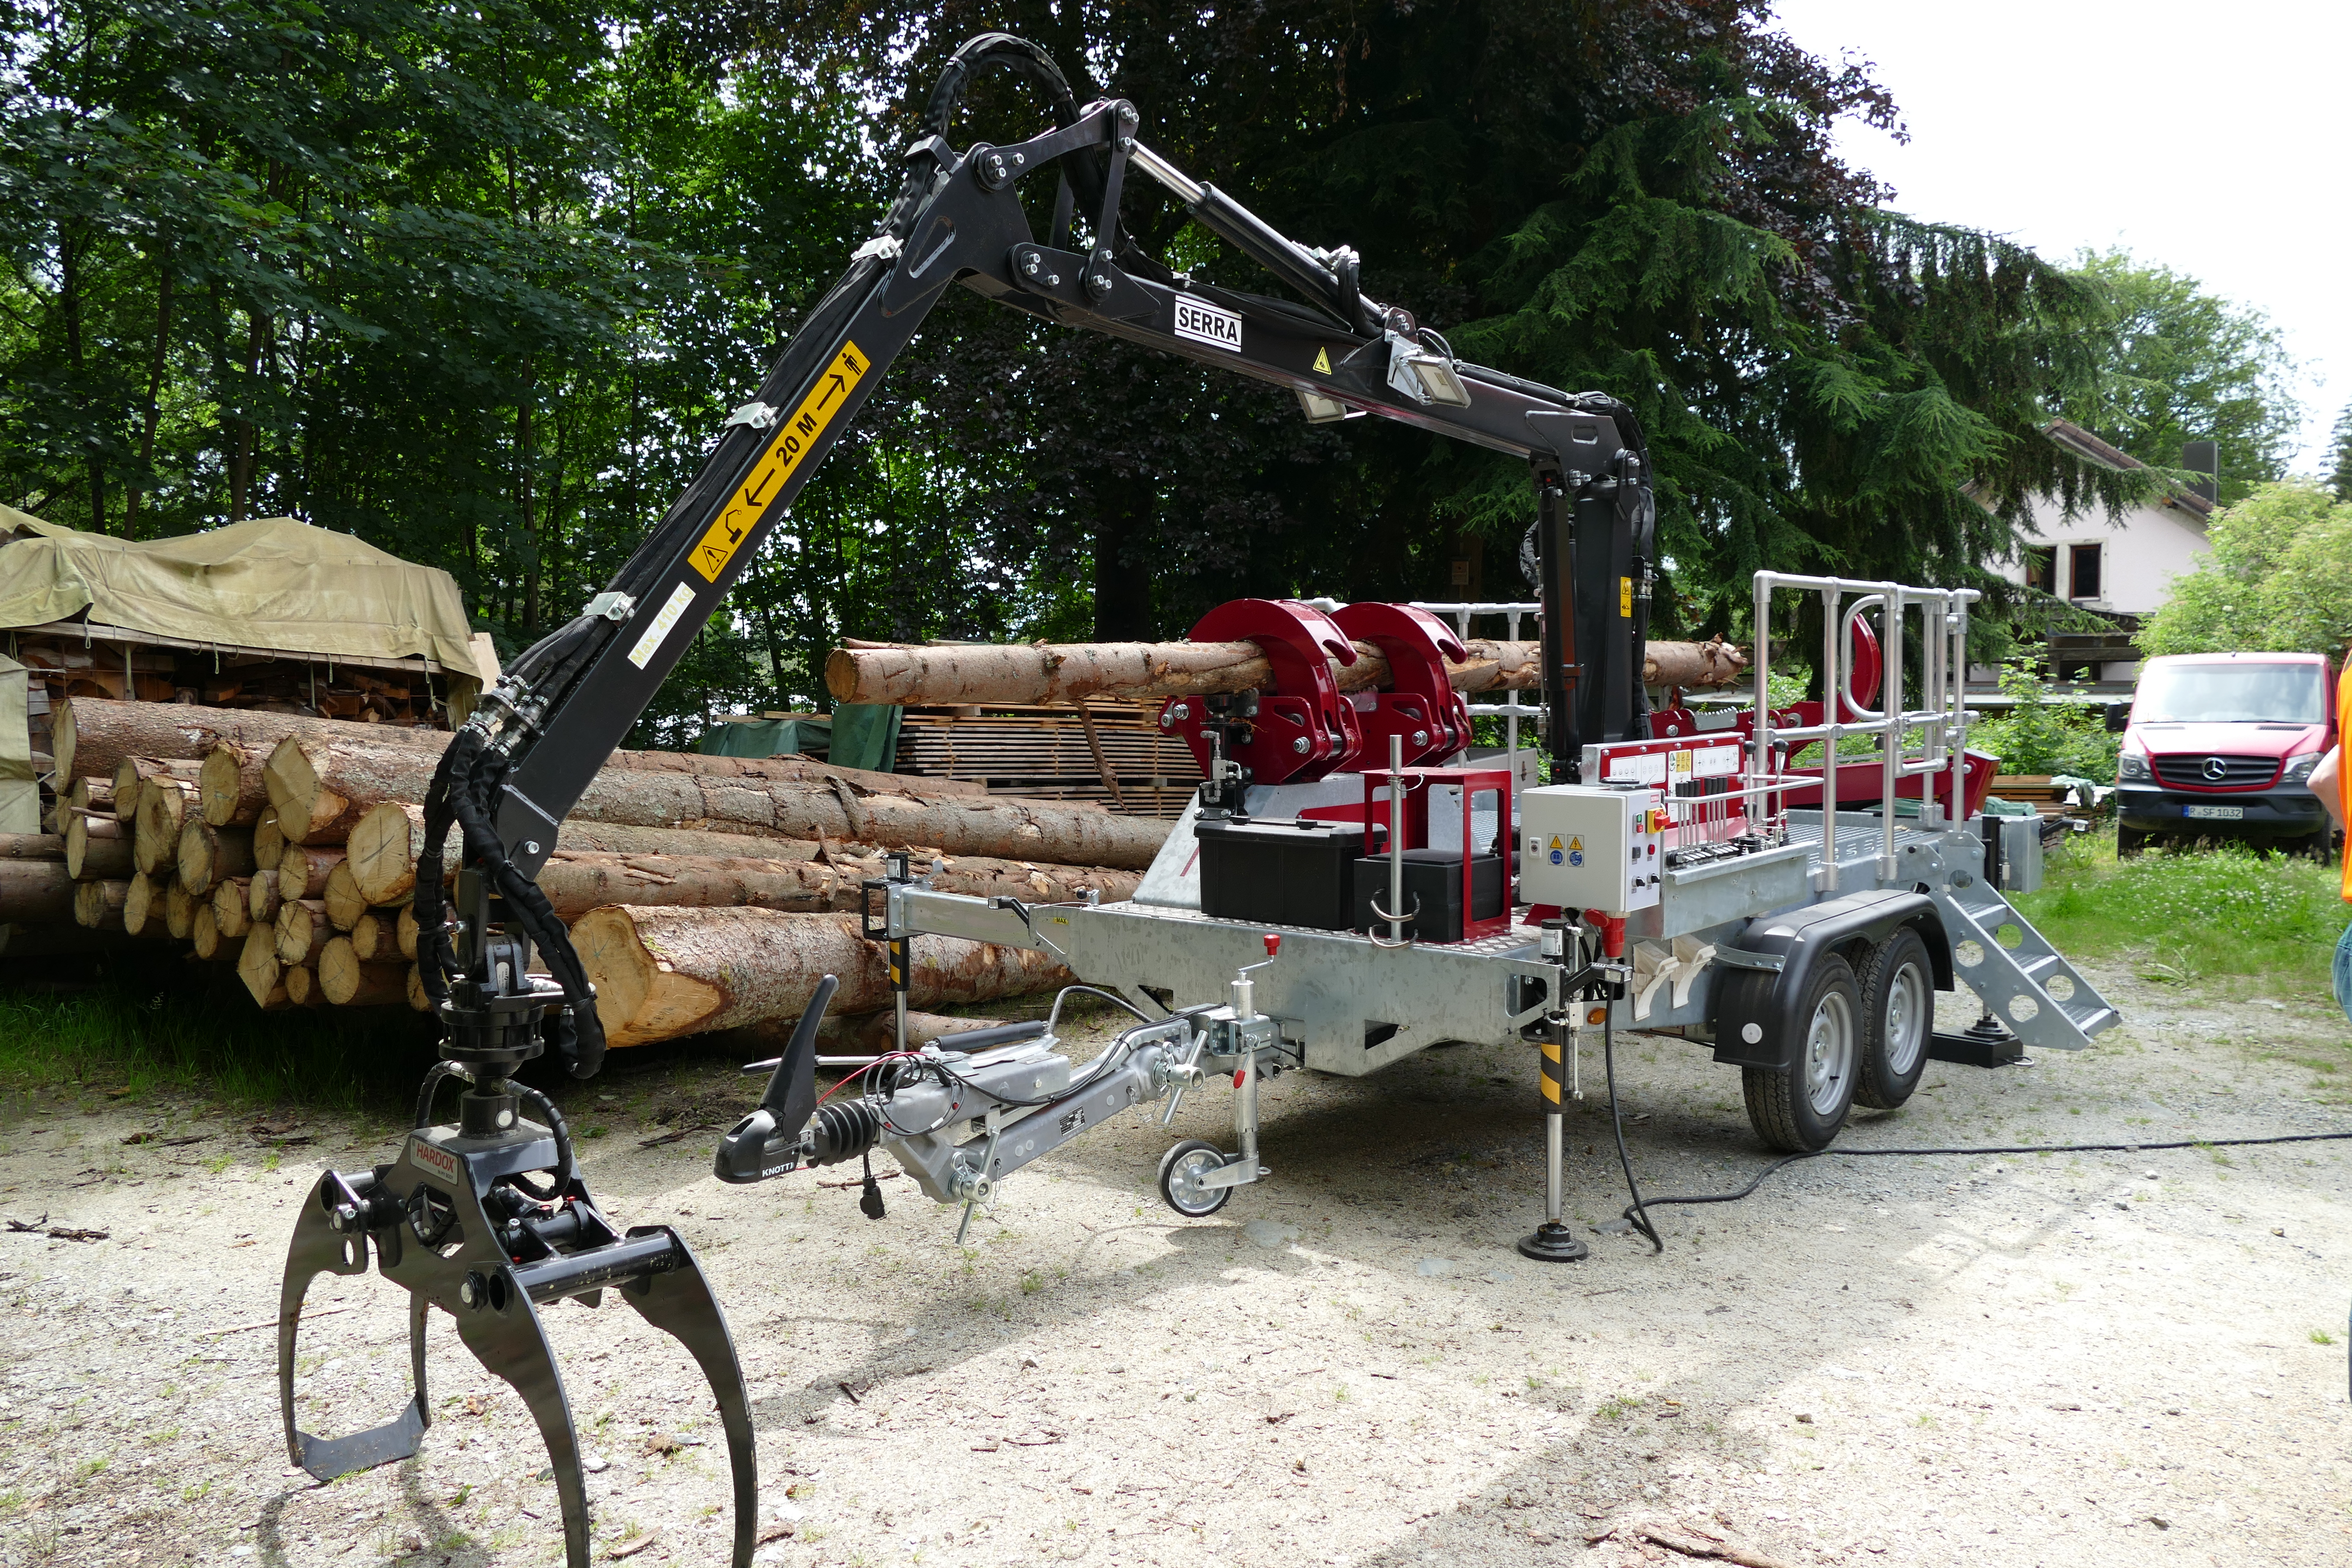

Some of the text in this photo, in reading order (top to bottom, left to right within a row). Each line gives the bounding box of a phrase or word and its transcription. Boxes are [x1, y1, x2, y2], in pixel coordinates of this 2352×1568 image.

[1179, 306, 1238, 342] SERRA
[776, 412, 818, 468] 20 M
[630, 586, 694, 666] Max. 410 kg
[2190, 808, 2242, 817] R SF 1032
[416, 1143, 454, 1173] HARDOX
[762, 1163, 790, 1177] KNOTT
